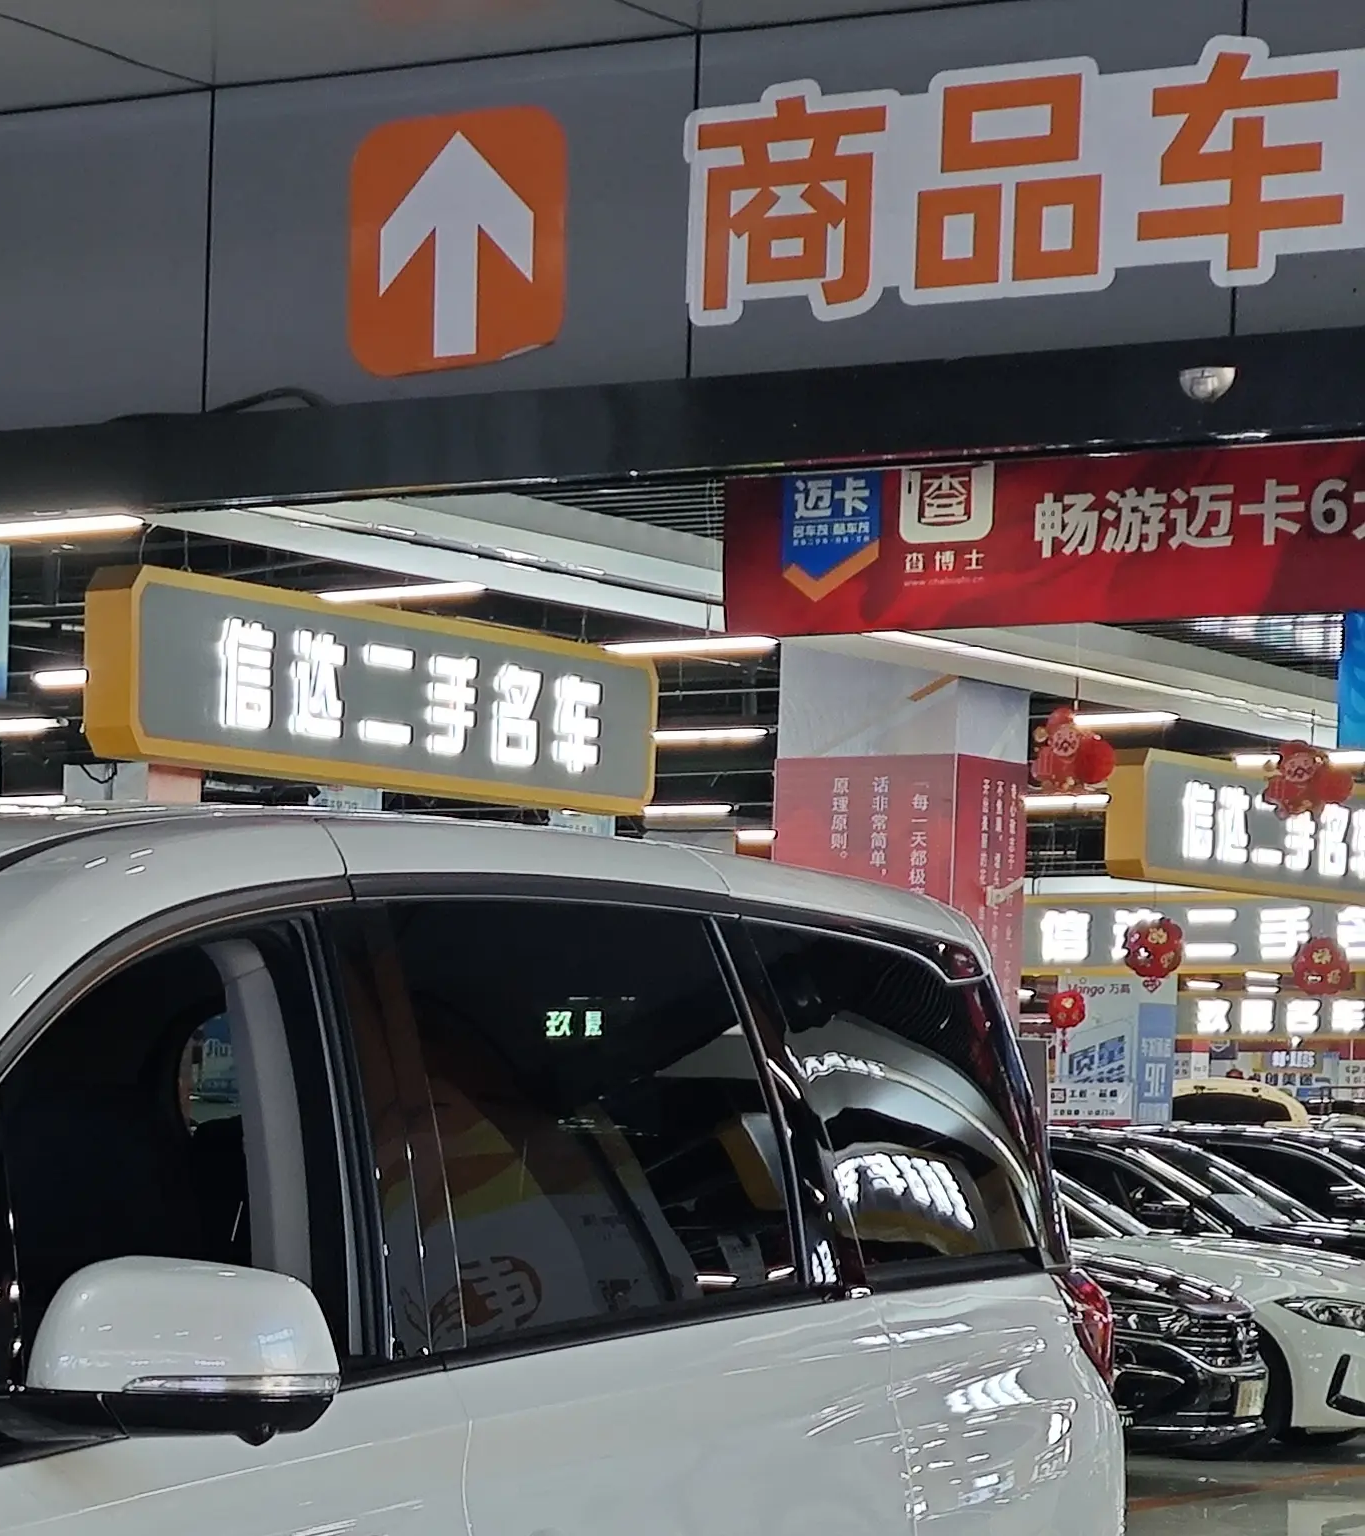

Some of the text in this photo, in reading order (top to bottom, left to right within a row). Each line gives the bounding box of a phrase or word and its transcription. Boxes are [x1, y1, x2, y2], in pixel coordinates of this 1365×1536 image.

[697, 52, 1344, 311] 商品车
[794, 477, 870, 519] 迈卡
[1034, 478, 1365, 558] 畅游迈卡6
[904, 549, 985, 573] 查博士
[219, 616, 603, 773] 信达二手名车
[1180, 779, 1365, 878] 信达二手名
